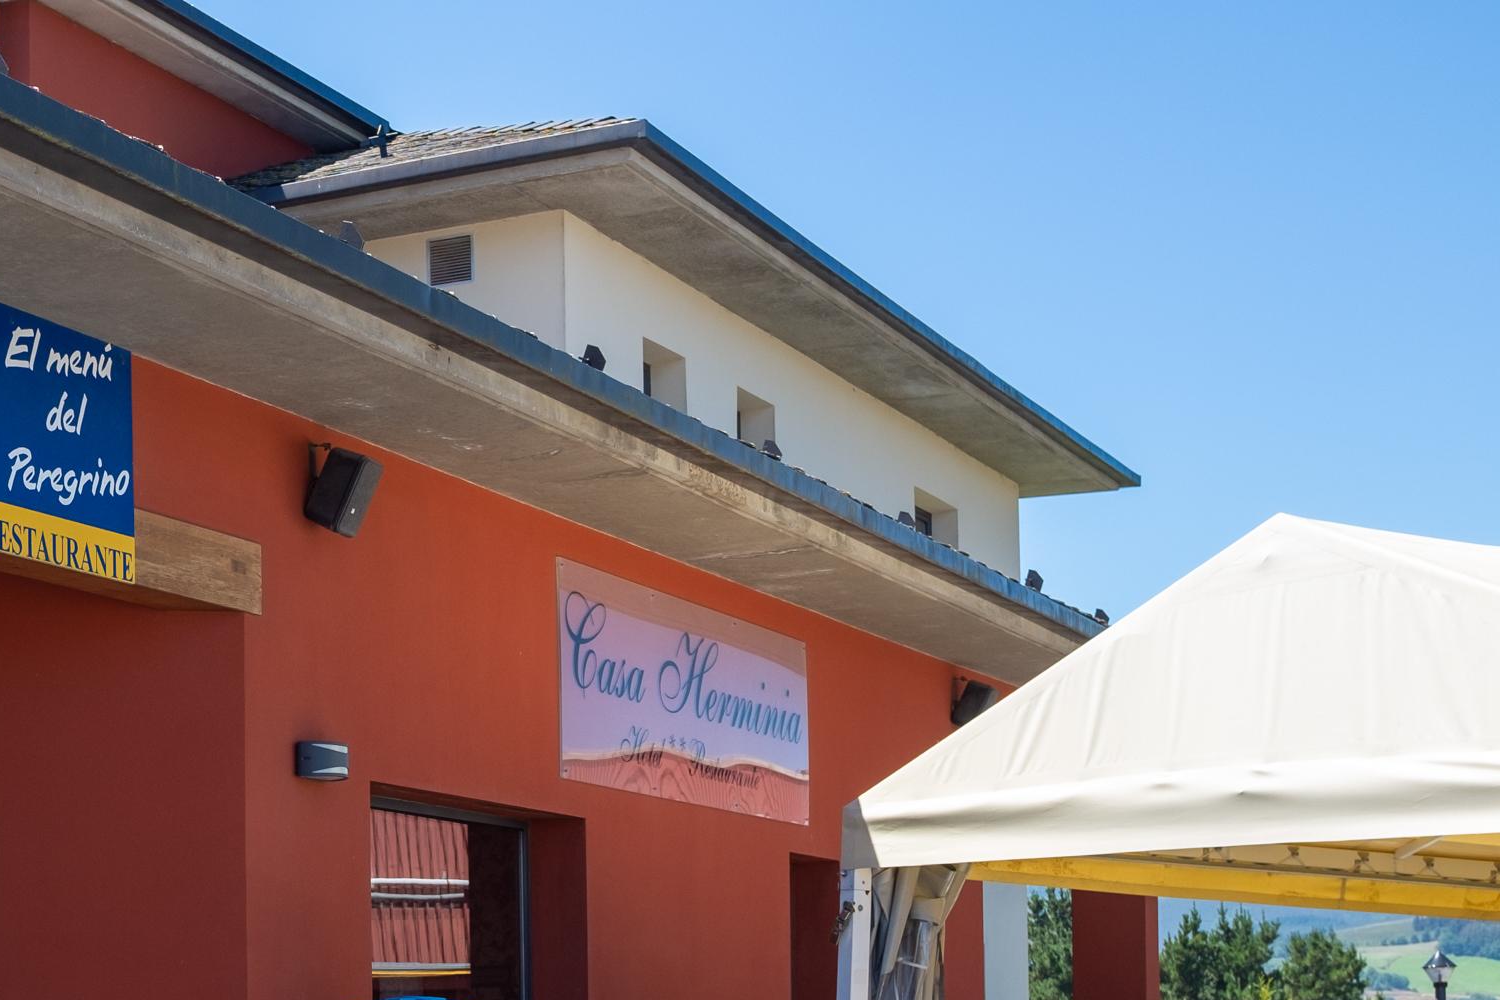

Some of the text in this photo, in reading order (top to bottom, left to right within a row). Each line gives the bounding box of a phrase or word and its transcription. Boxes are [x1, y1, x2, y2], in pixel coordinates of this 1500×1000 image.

[4, 327, 114, 382] El menú
[45, 392, 87, 435] del
[7, 446, 130, 505] Peregrino
[565, 591, 802, 744] Casa Herminia
[688, 738, 761, 789] Restaurante
